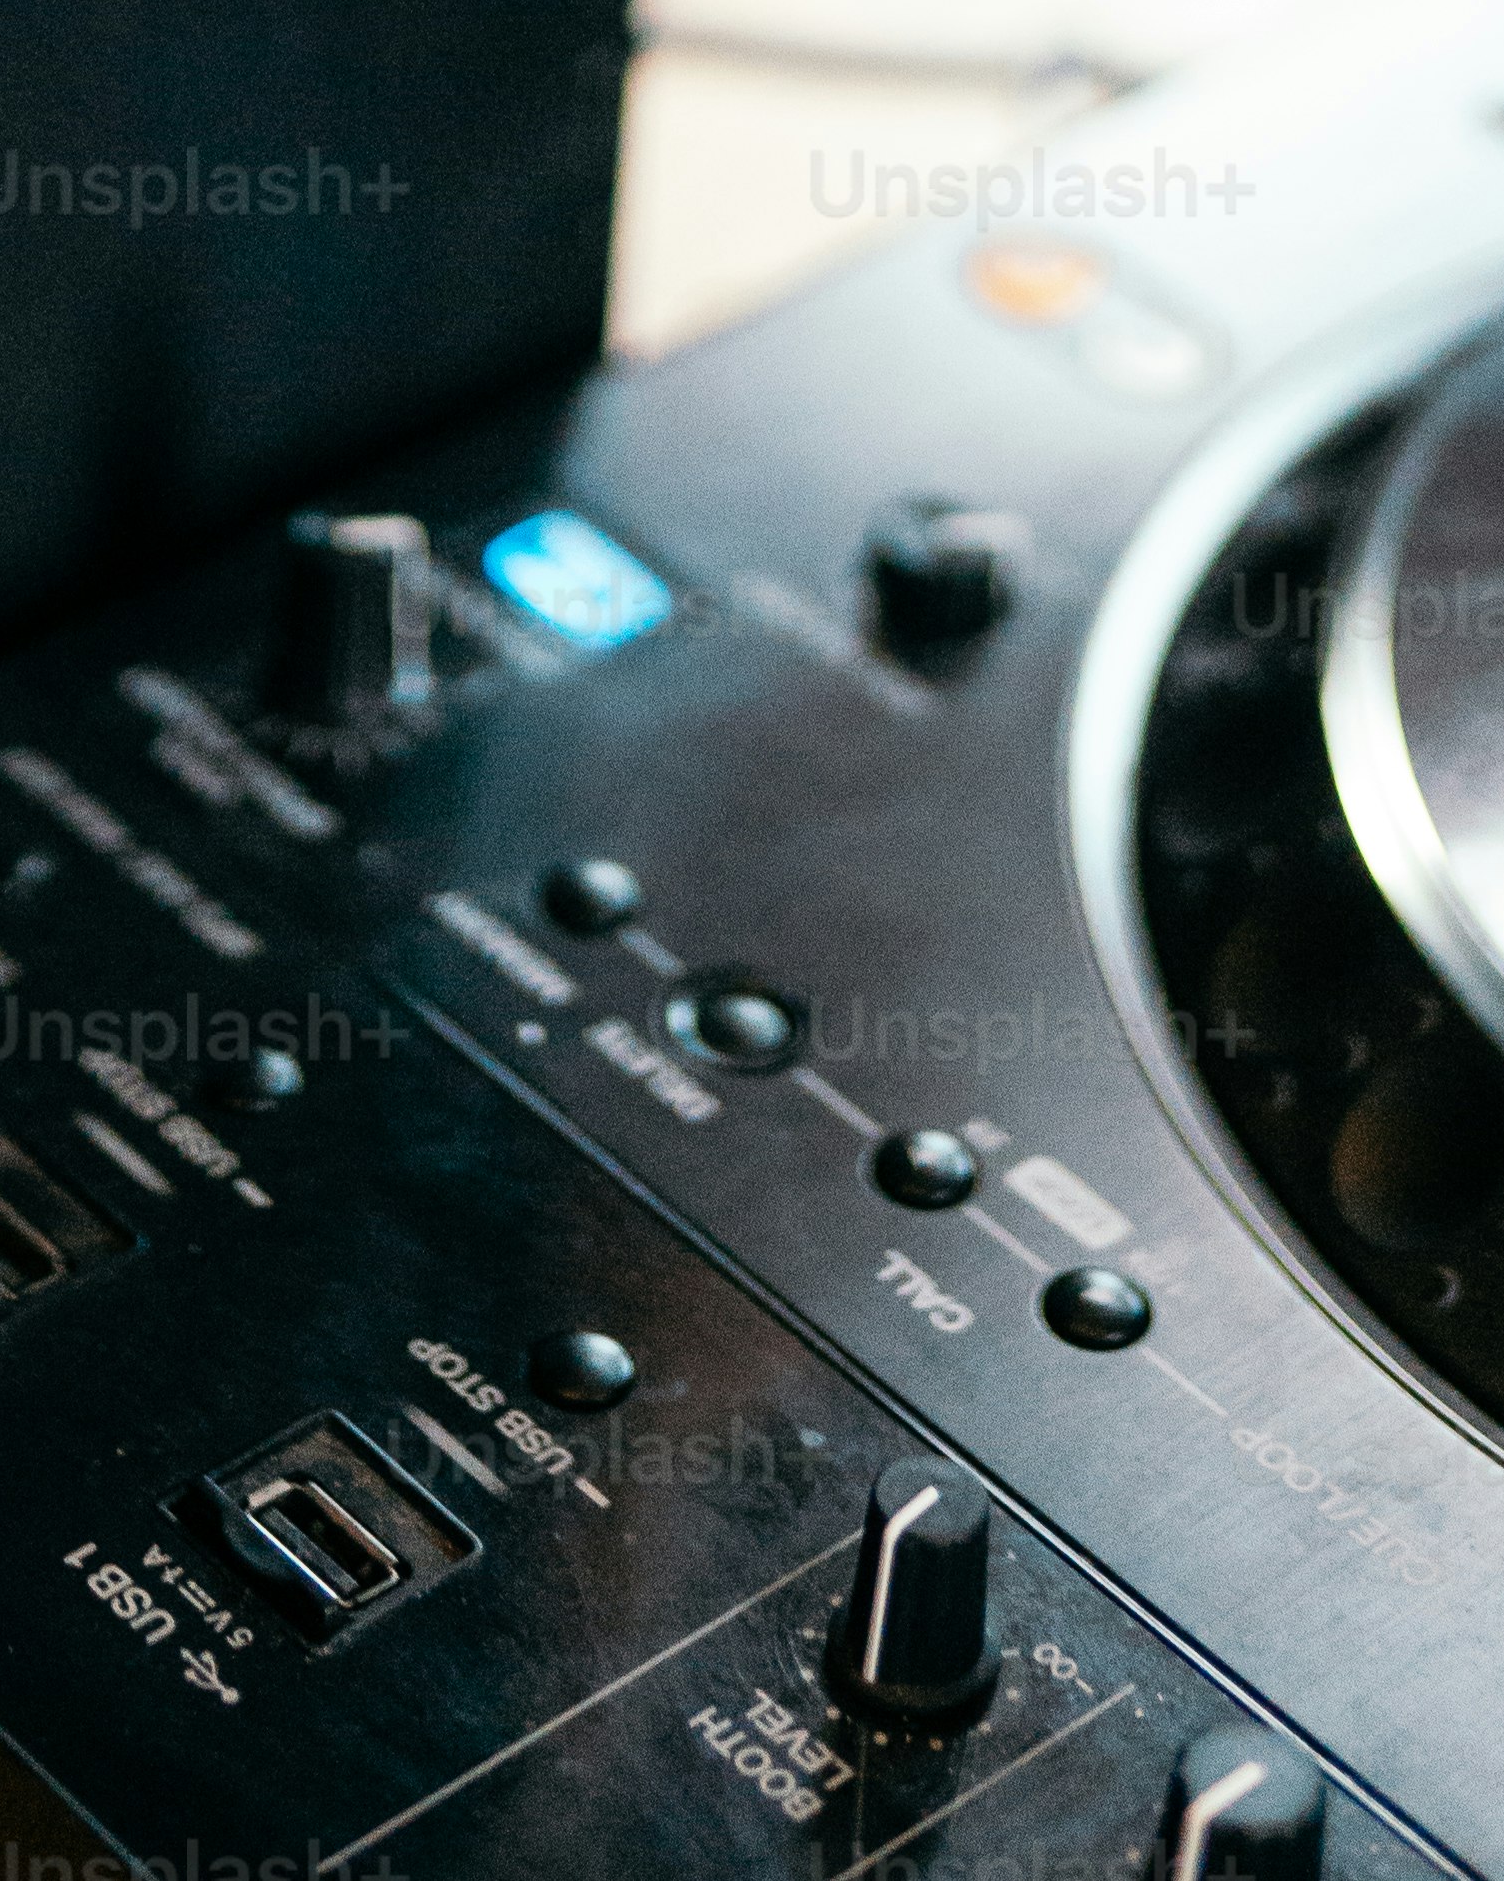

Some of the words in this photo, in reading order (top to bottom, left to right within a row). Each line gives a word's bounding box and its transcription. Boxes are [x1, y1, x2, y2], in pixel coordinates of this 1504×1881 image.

[878, 1252, 975, 1334] CALL
[407, 1339, 506, 1412] STOP
[495, 1409, 574, 1475] USB
[1231, 1426, 1445, 1587] CUE/LOOP
[63, 1541, 98, 1569] 1
[87, 1563, 177, 1645] USB
[688, 1706, 825, 1823] BOOTH
[745, 1689, 855, 1790] LEVEL
